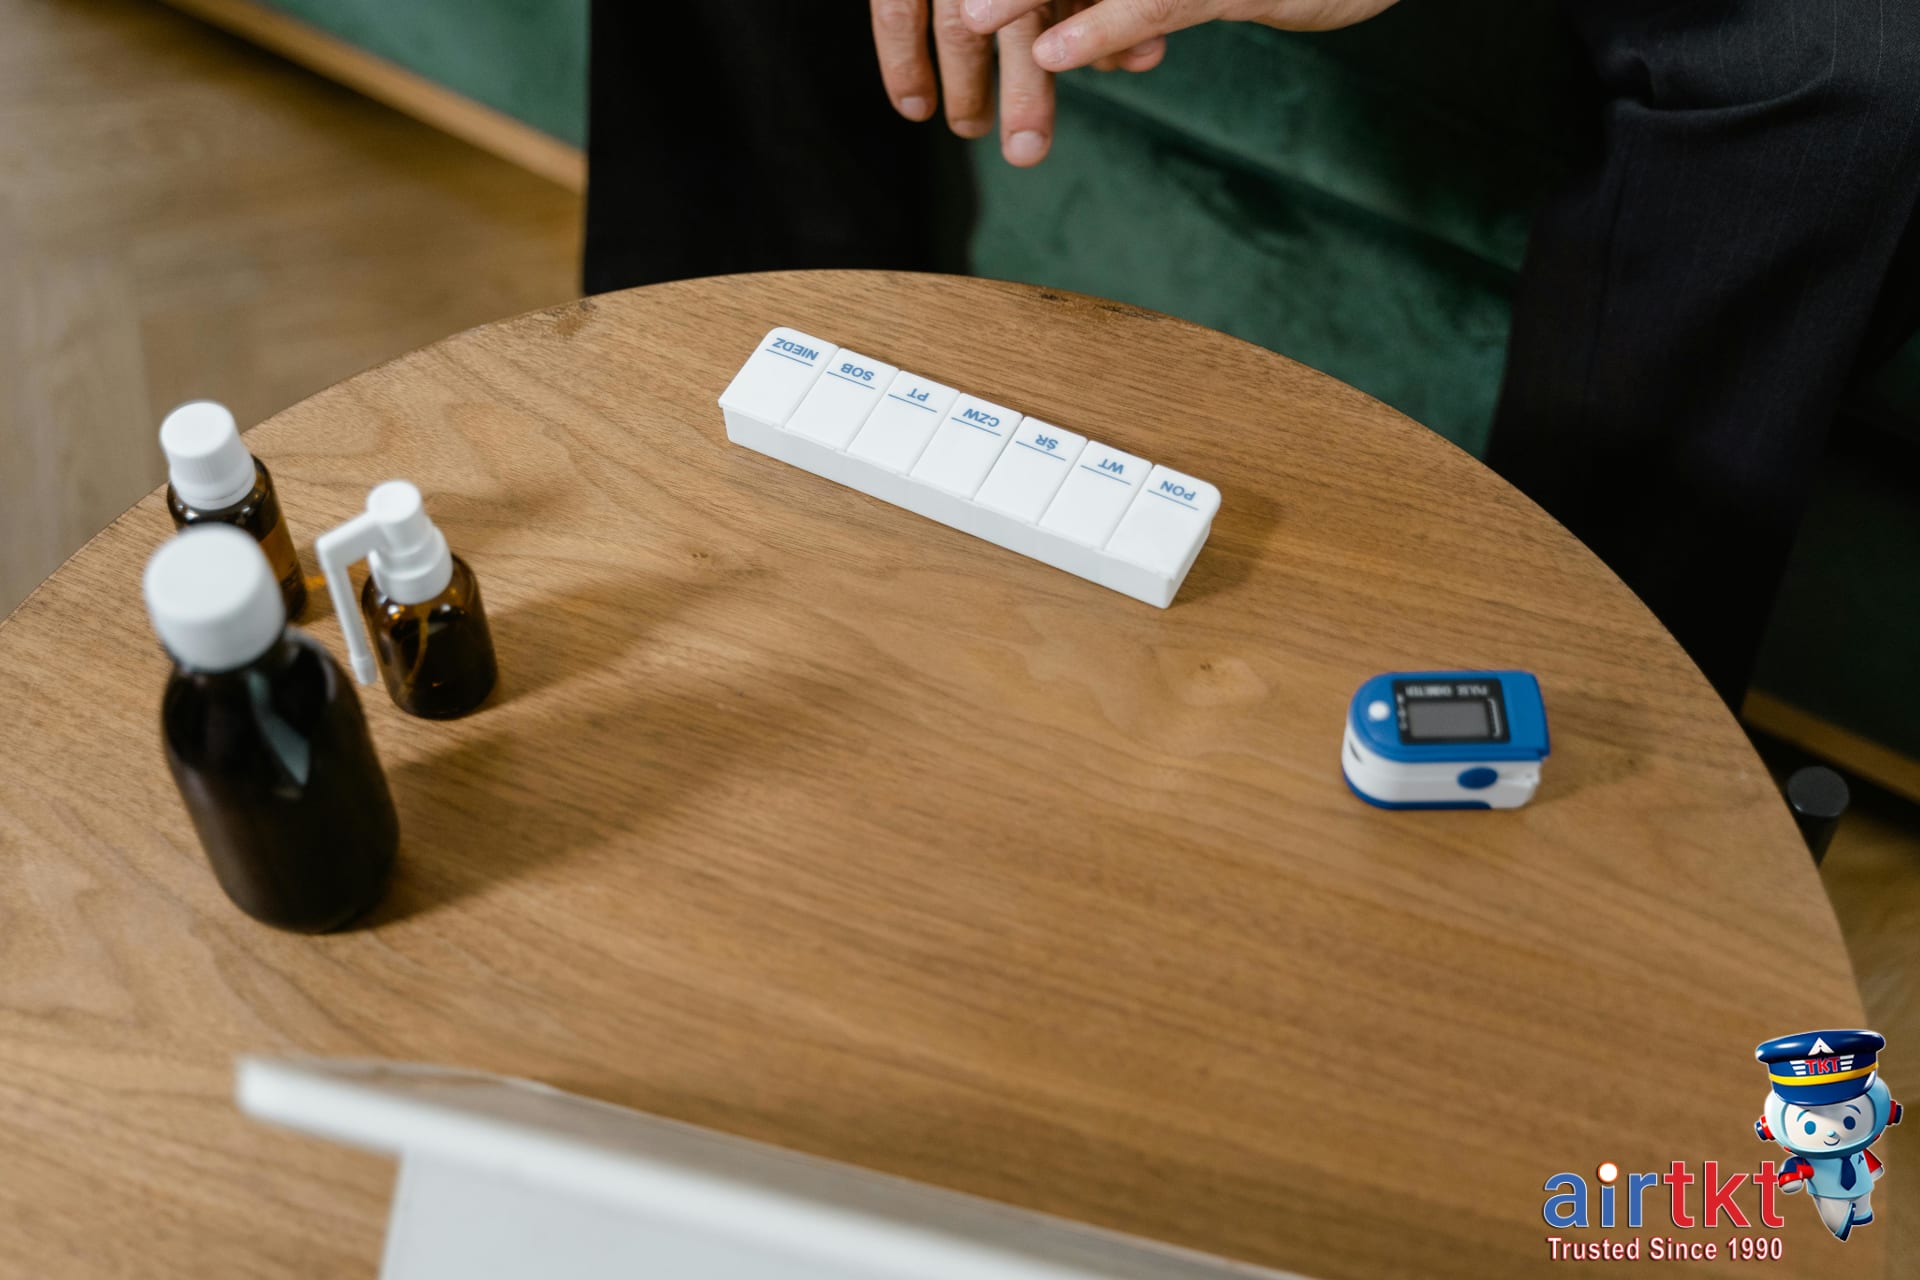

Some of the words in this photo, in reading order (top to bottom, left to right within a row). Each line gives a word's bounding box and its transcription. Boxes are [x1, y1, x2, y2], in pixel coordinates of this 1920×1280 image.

[772, 337, 819, 361] NIEDZ
[840, 363, 874, 381] SOB
[906, 387, 930, 402] PT
[962, 407, 1000, 428] CZW
[1097, 458, 1124, 475] WT
[1160, 480, 1196, 501] PON
